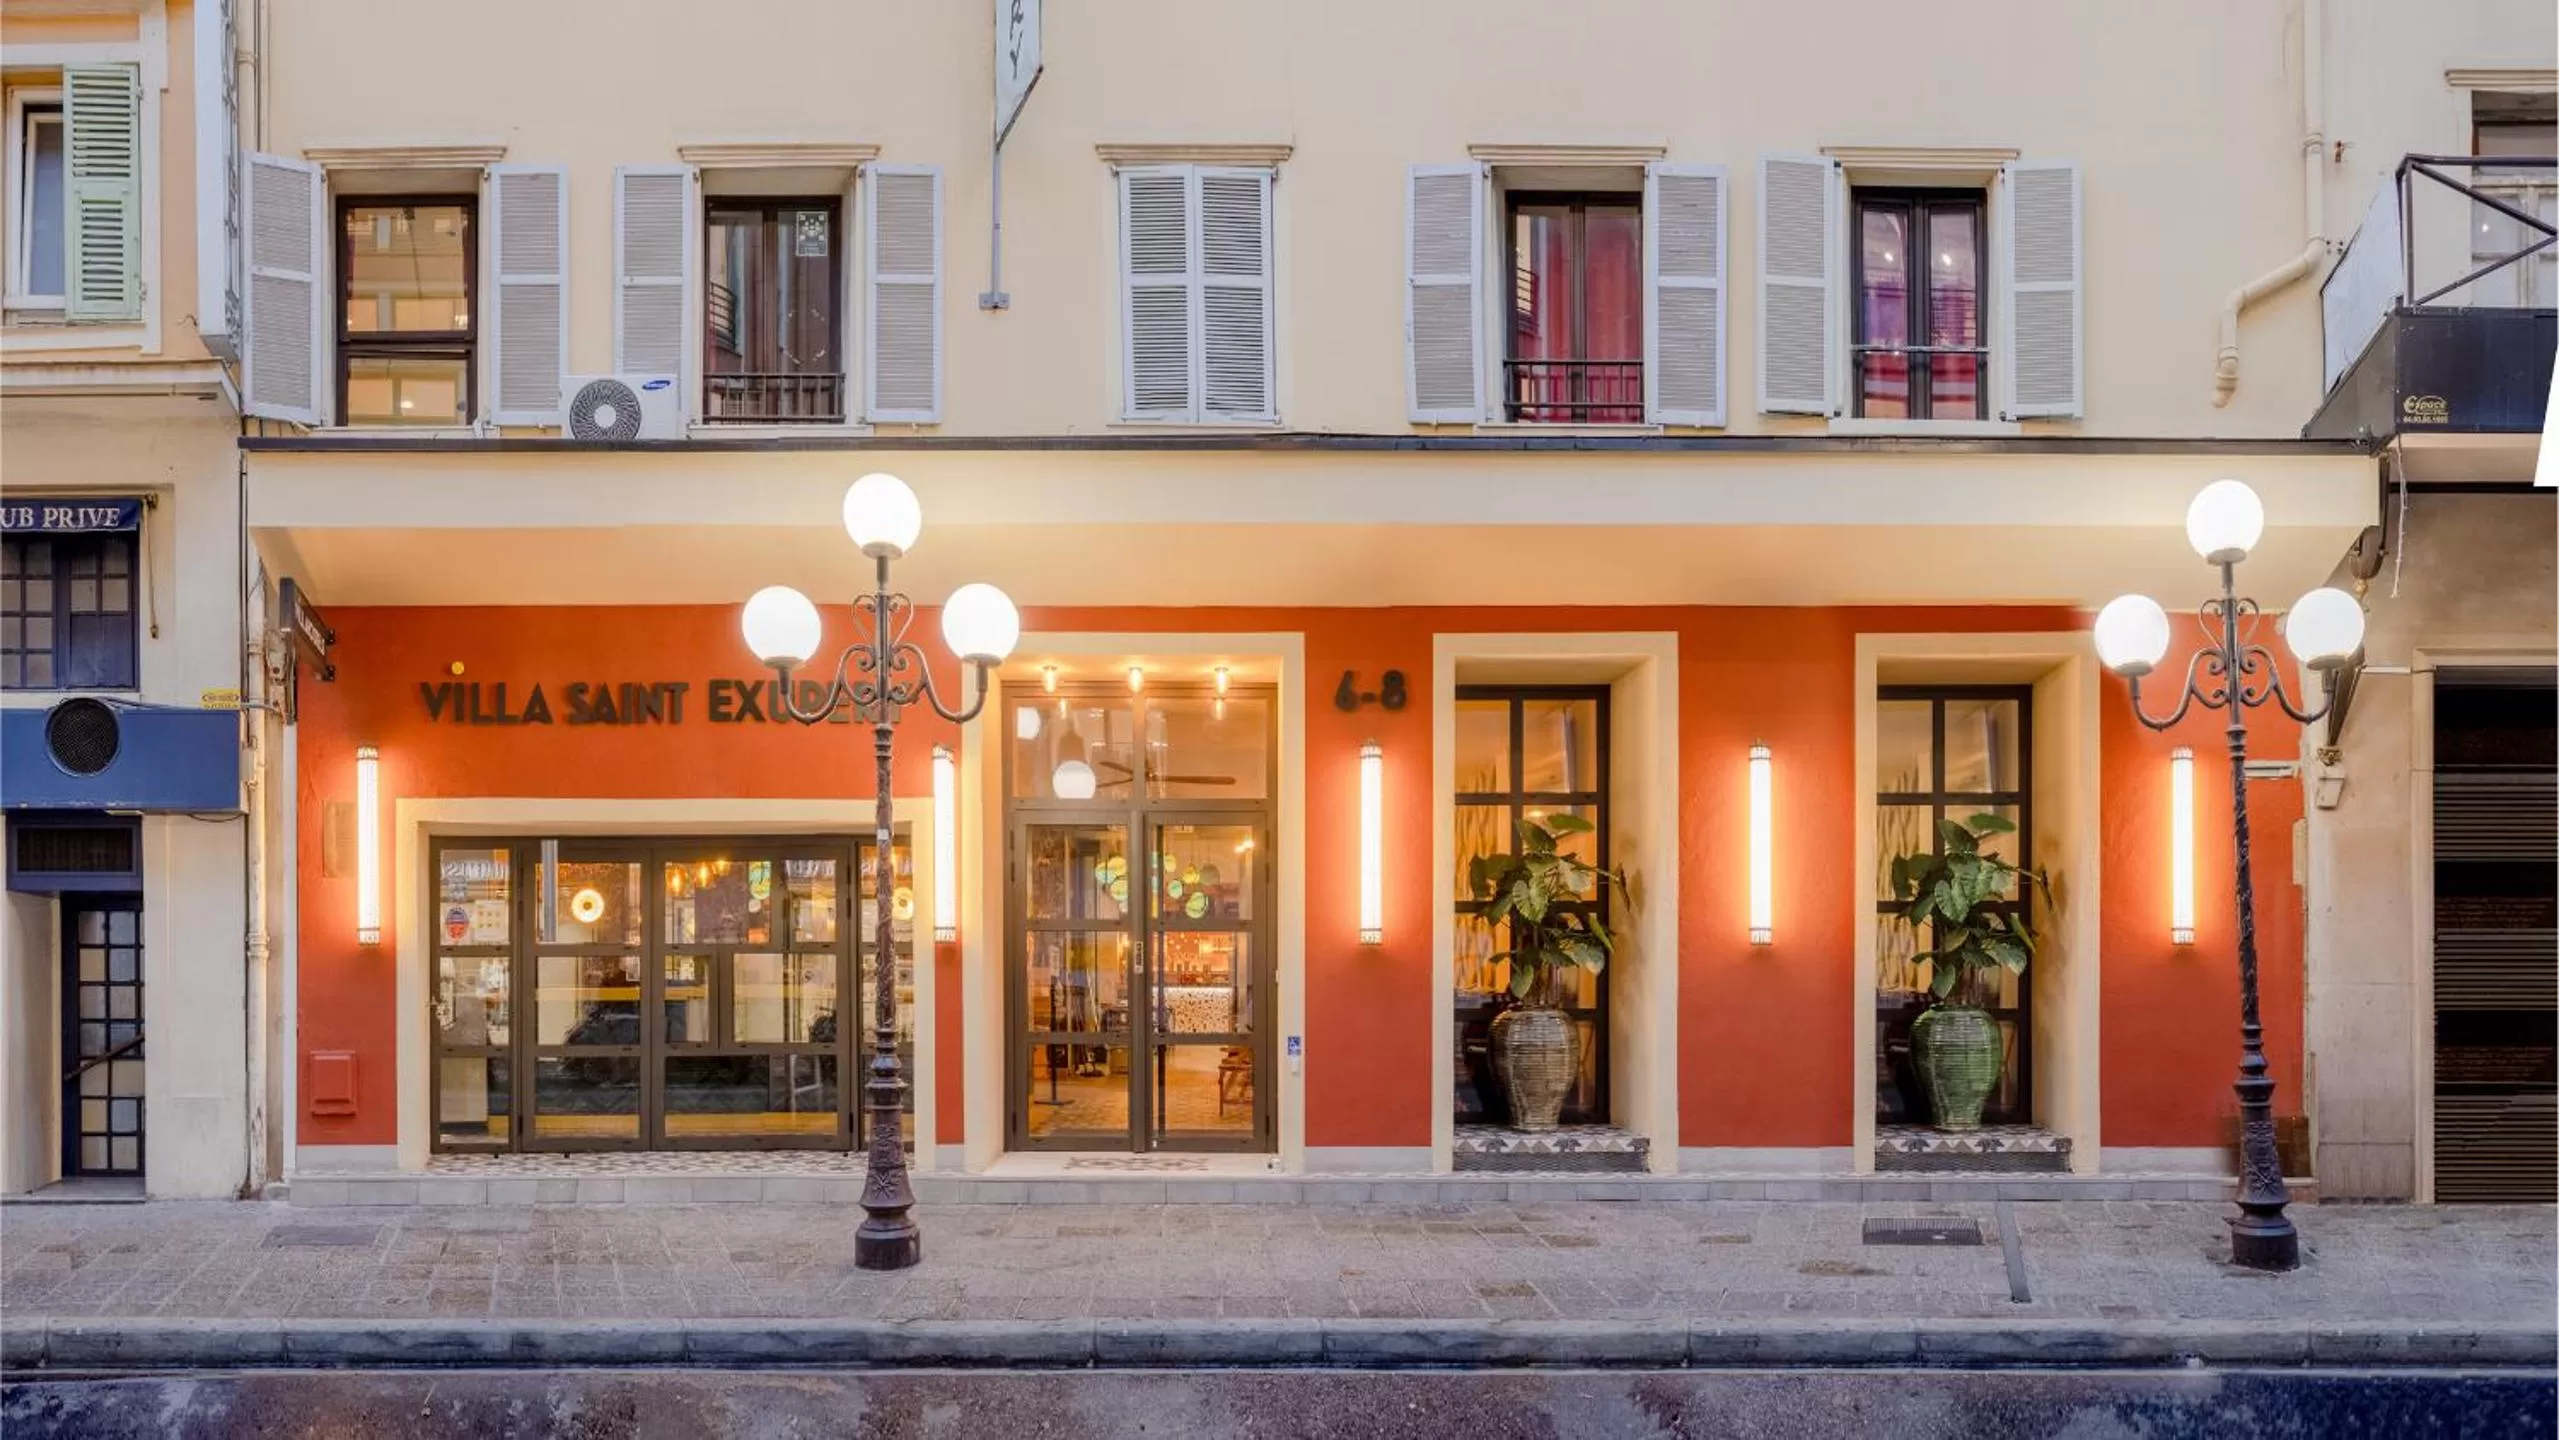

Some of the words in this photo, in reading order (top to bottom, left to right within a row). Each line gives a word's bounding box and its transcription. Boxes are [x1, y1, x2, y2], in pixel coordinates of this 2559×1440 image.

[42, 507, 120, 528] PRIVE
[417, 664, 554, 725] VILLA
[565, 681, 689, 725] SAINT
[1334, 669, 1407, 713] 6-8
